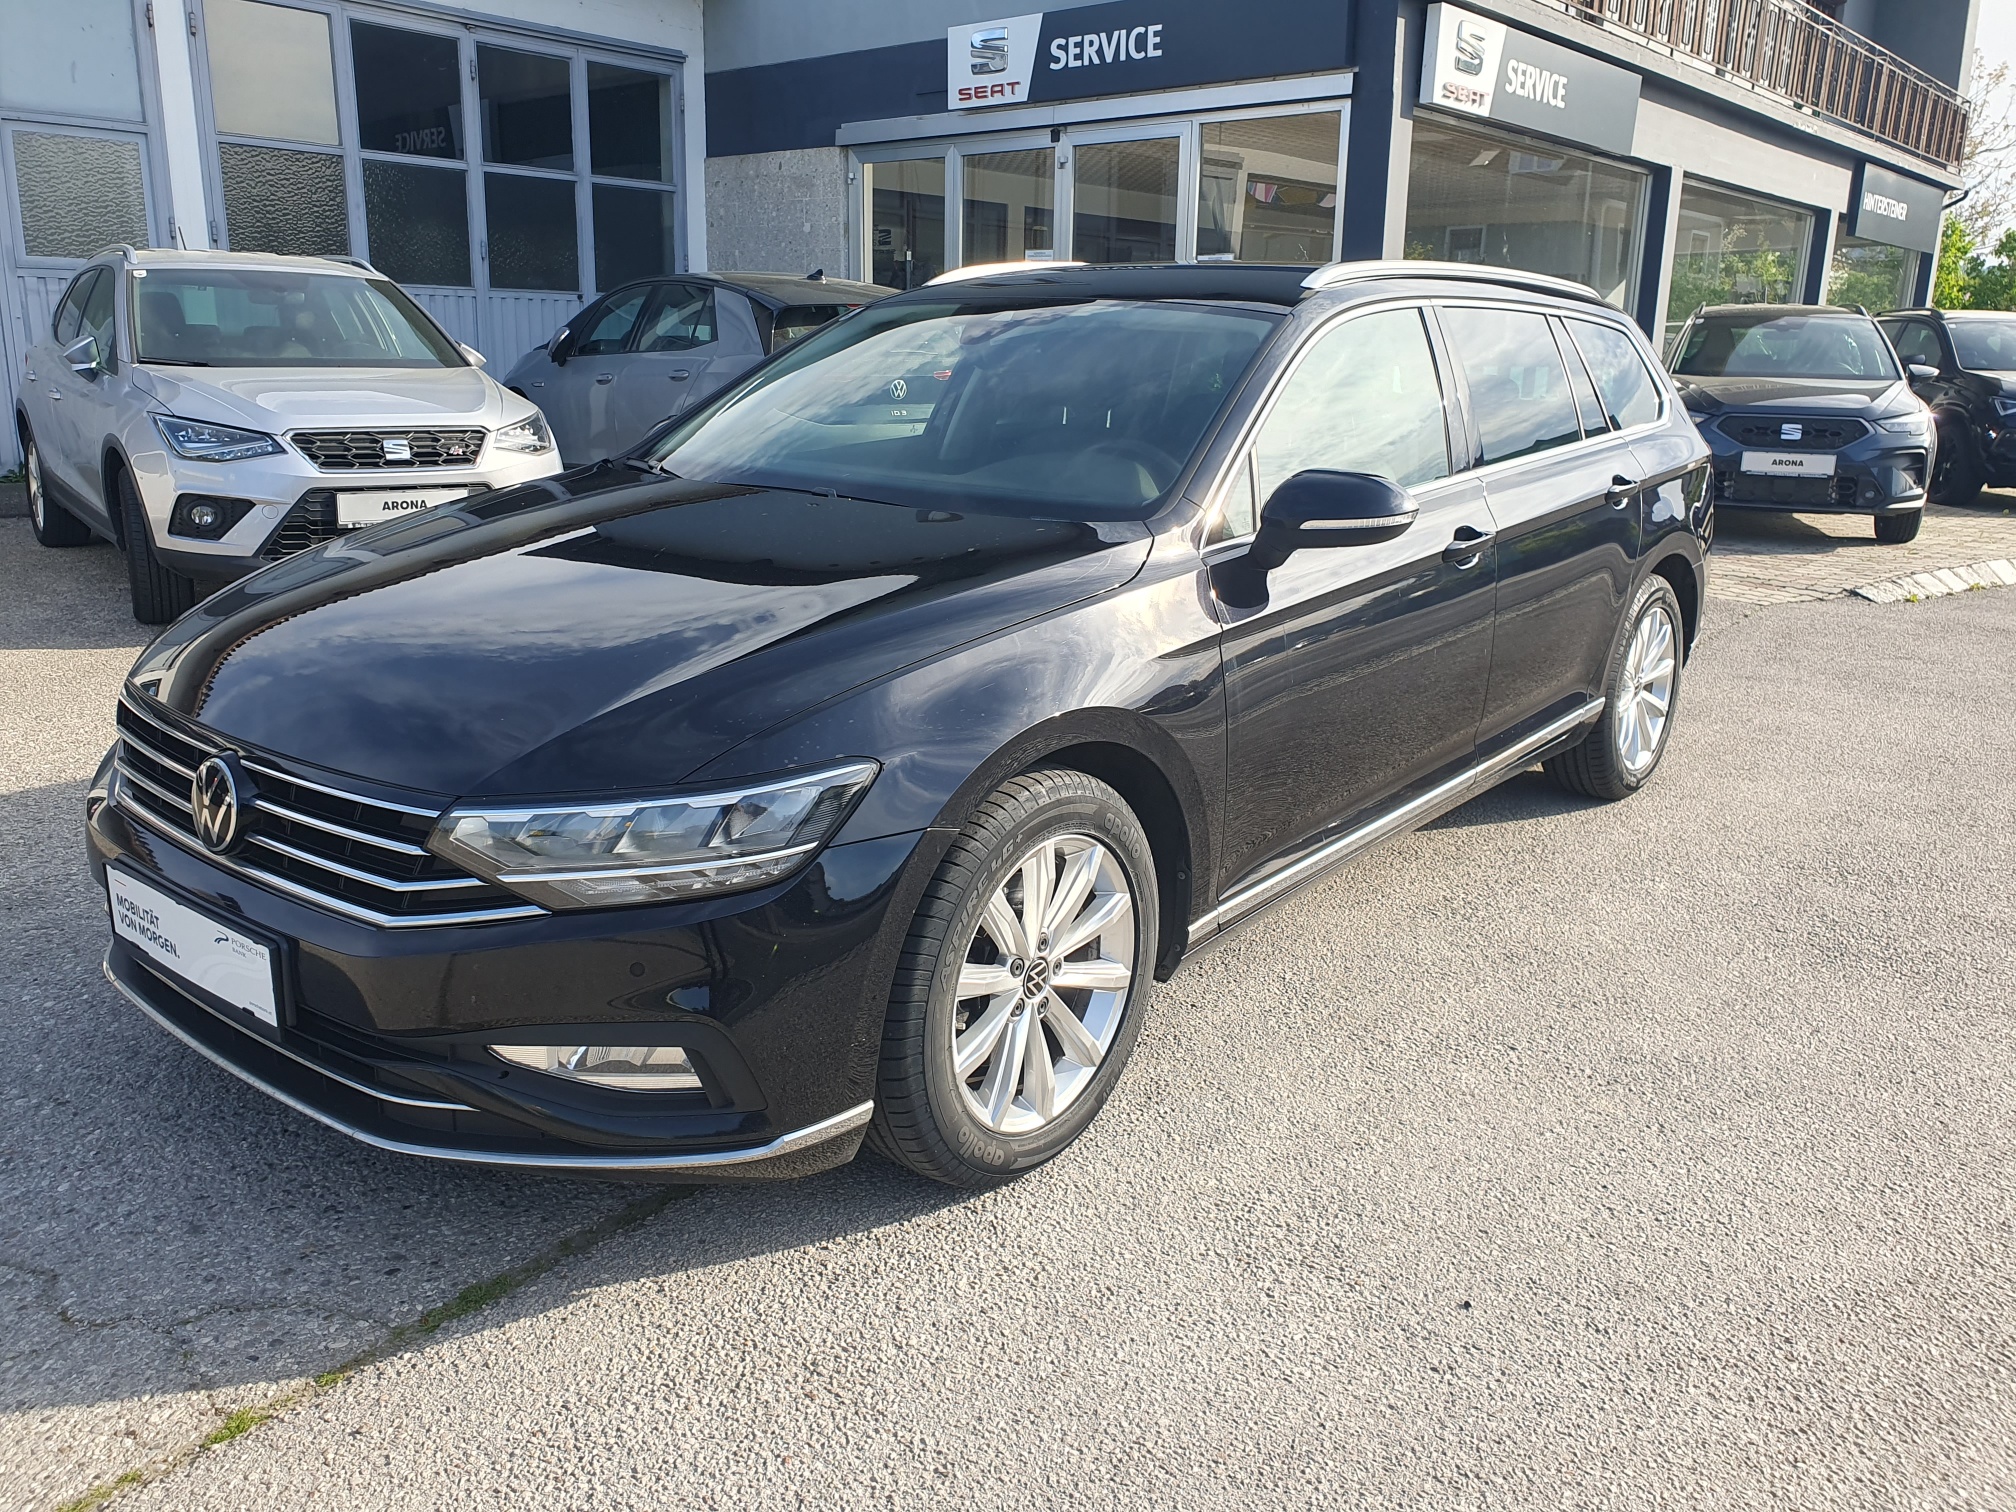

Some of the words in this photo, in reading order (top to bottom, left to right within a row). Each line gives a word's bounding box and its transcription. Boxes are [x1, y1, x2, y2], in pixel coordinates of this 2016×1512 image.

[1049, 24, 1163, 71] SERVICE
[958, 81, 1021, 102] SEAT
[1442, 81, 1490, 108] SEAT
[1505, 58, 1568, 109] SERVICE
[1863, 191, 1908, 221] HINTERSTEINER
[1771, 459, 1804, 467] ARONA
[382, 499, 428, 511] ARONA
[1103, 812, 1141, 859] apollo
[116, 893, 160, 930] MOBILITÄT
[118, 909, 137, 933] VON
[138, 927, 181, 959] MORGEN.
[940, 871, 989, 992] ASPIRE
[231, 937, 267, 961] PORSCHE
[232, 946, 247, 959] BANK
[957, 1126, 1005, 1166] apollo
